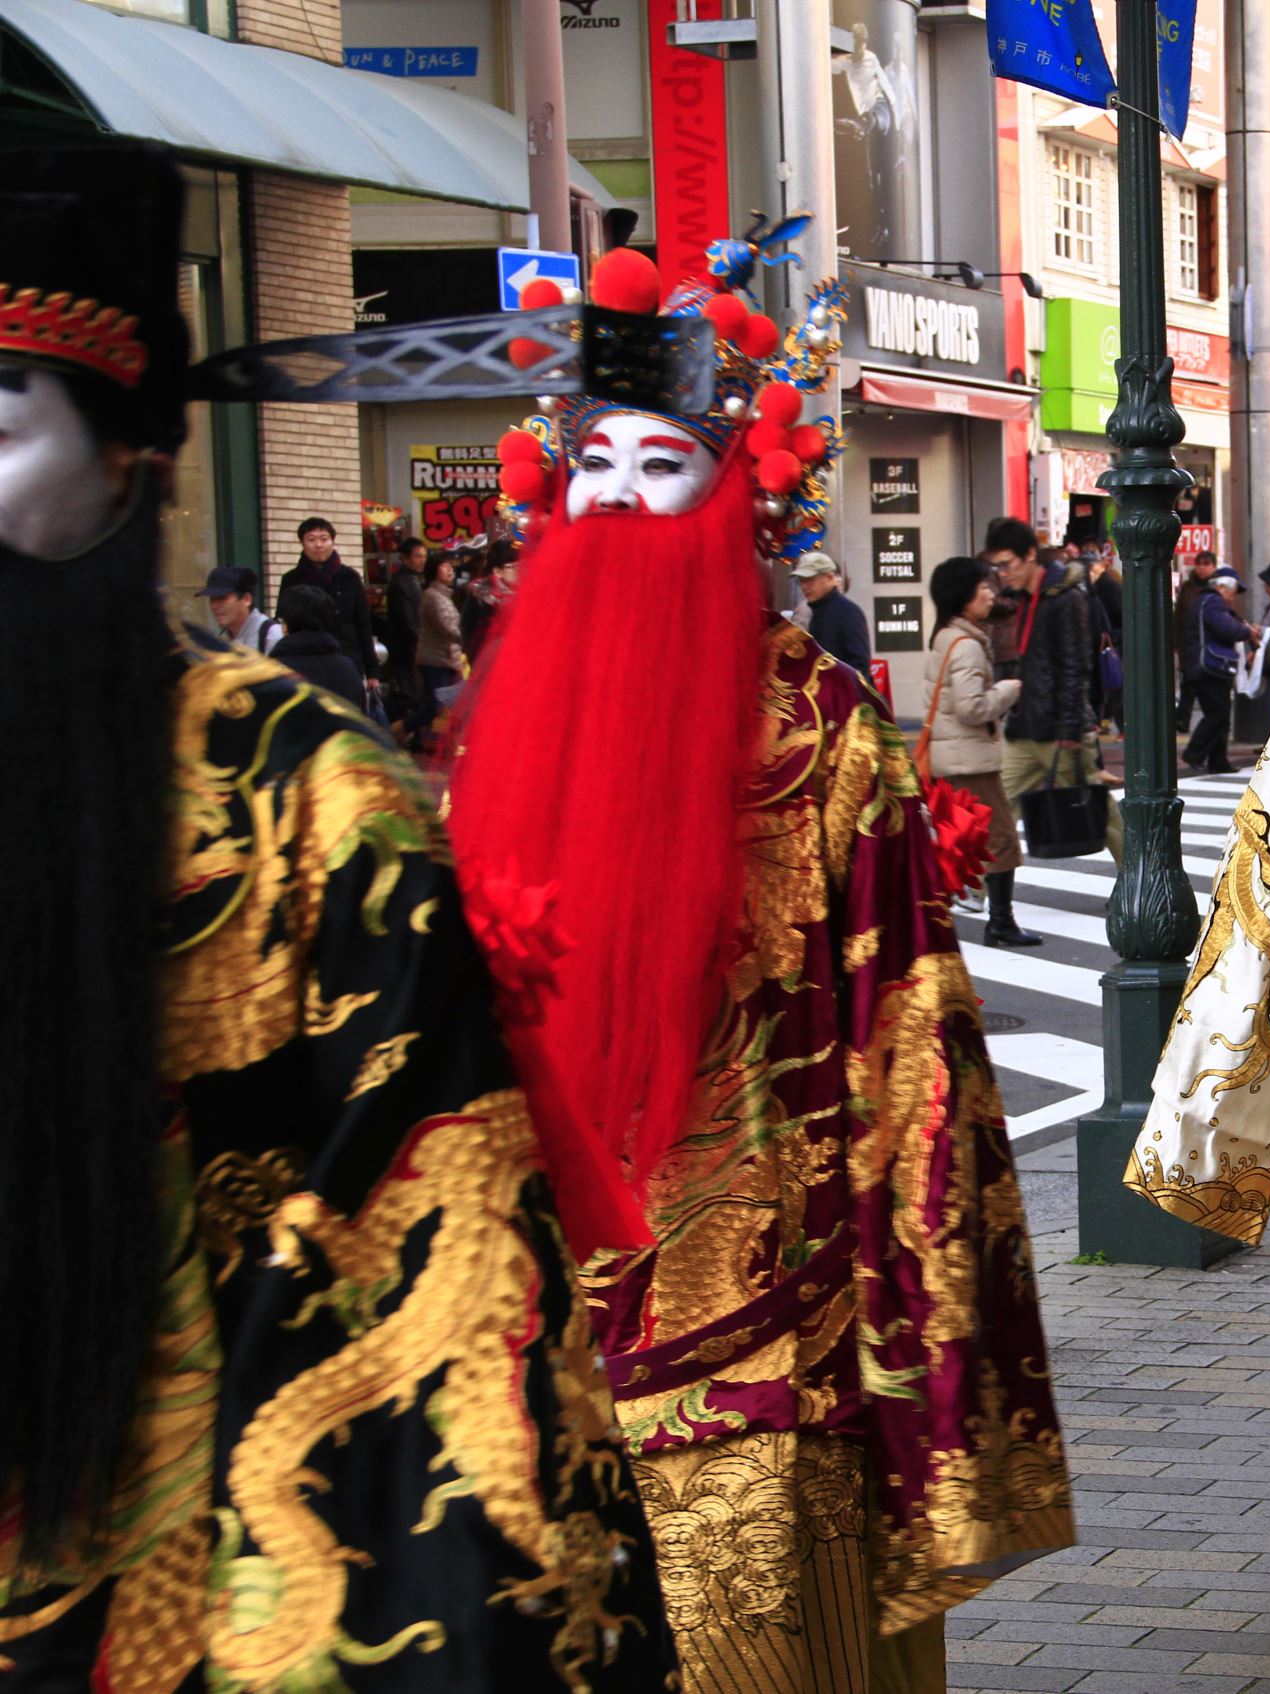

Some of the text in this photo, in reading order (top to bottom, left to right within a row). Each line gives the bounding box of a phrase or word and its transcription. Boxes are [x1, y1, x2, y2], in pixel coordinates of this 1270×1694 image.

[561, 15, 621, 29] MIZUNO
[997, 37, 1053, 66] 神戸市
[404, 49, 464, 75] PEACE
[412, 460, 499, 489] RUNN
[887, 466, 903, 477] 3F
[872, 483, 918, 494] BASEBALL
[888, 534, 904, 546] 2F
[879, 552, 914, 563] SOCCER
[879, 566, 914, 577] FUTSAL
[891, 604, 907, 615] 1F
[878, 621, 919, 633] RUNNING
